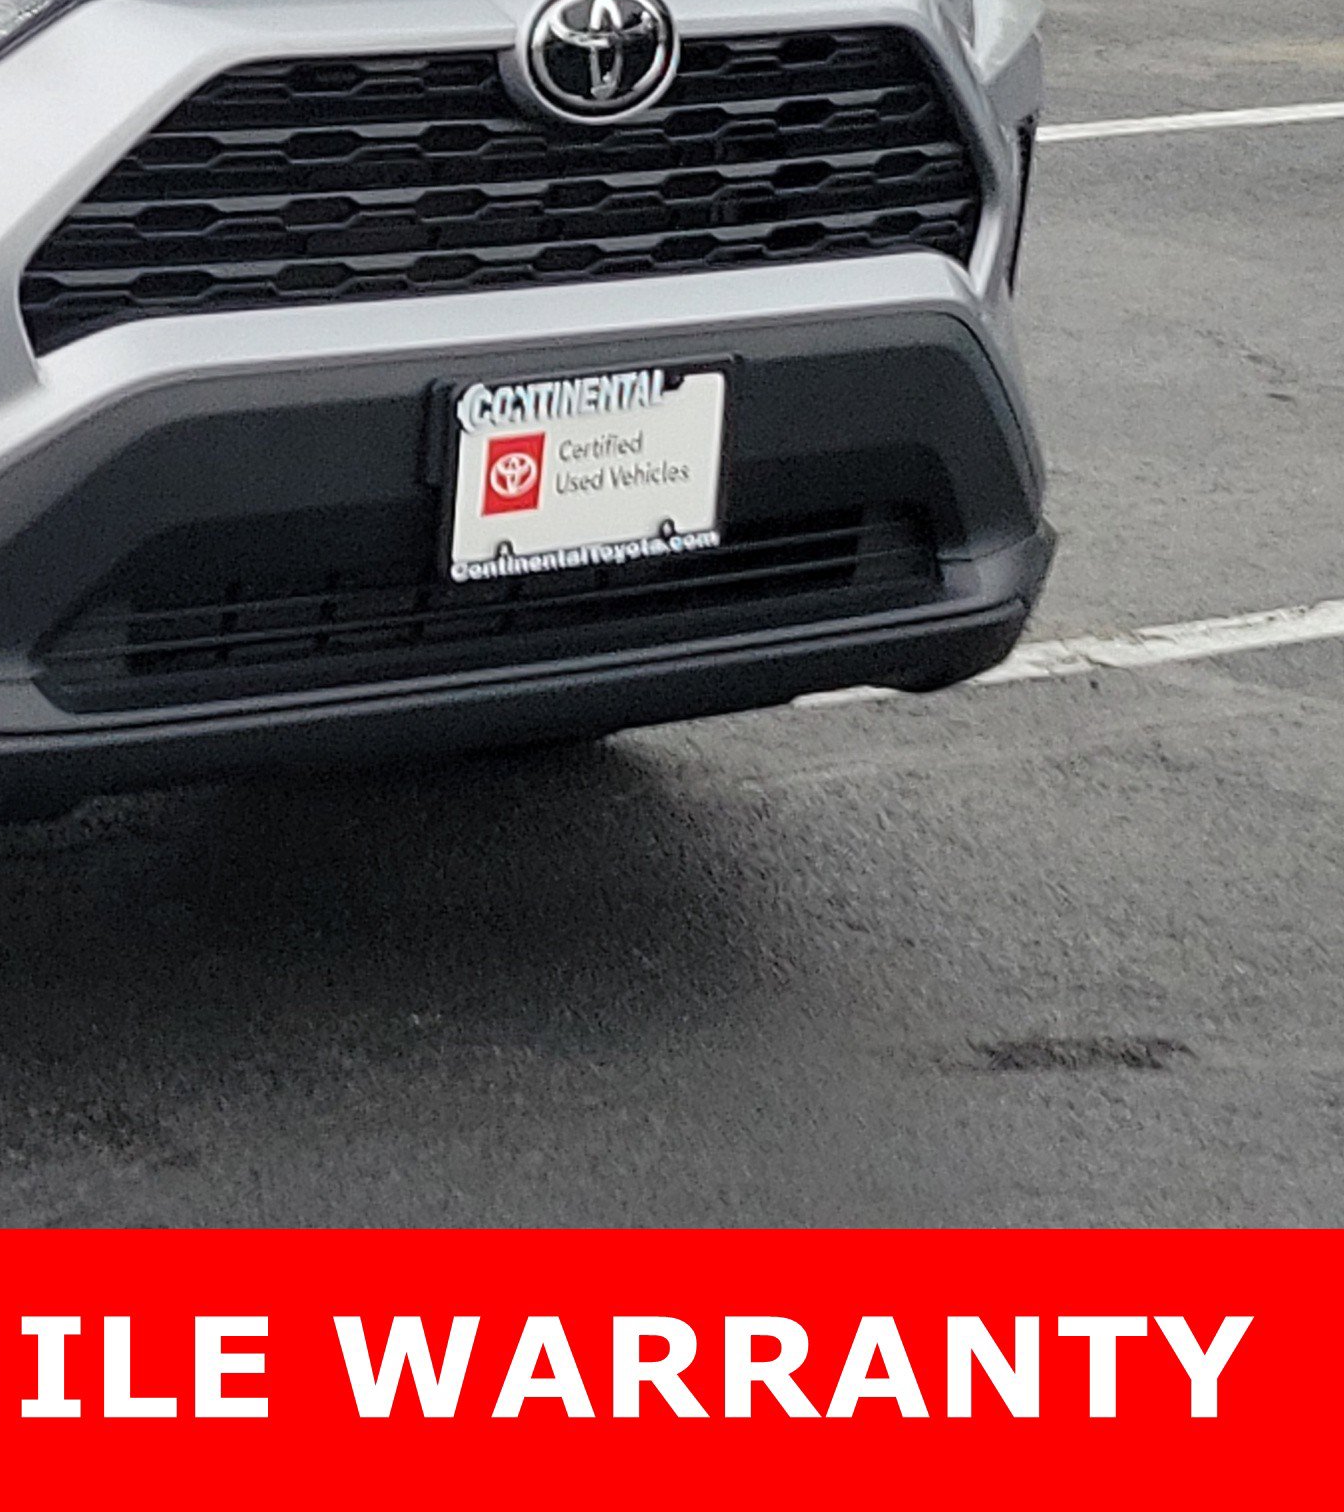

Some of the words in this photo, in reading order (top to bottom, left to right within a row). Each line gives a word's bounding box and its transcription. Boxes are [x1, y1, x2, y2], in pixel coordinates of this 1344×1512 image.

[458, 369, 663, 432] CONTINENTAL
[558, 430, 643, 462] Certified
[555, 467, 604, 495] Used
[610, 459, 691, 489] Vehicles
